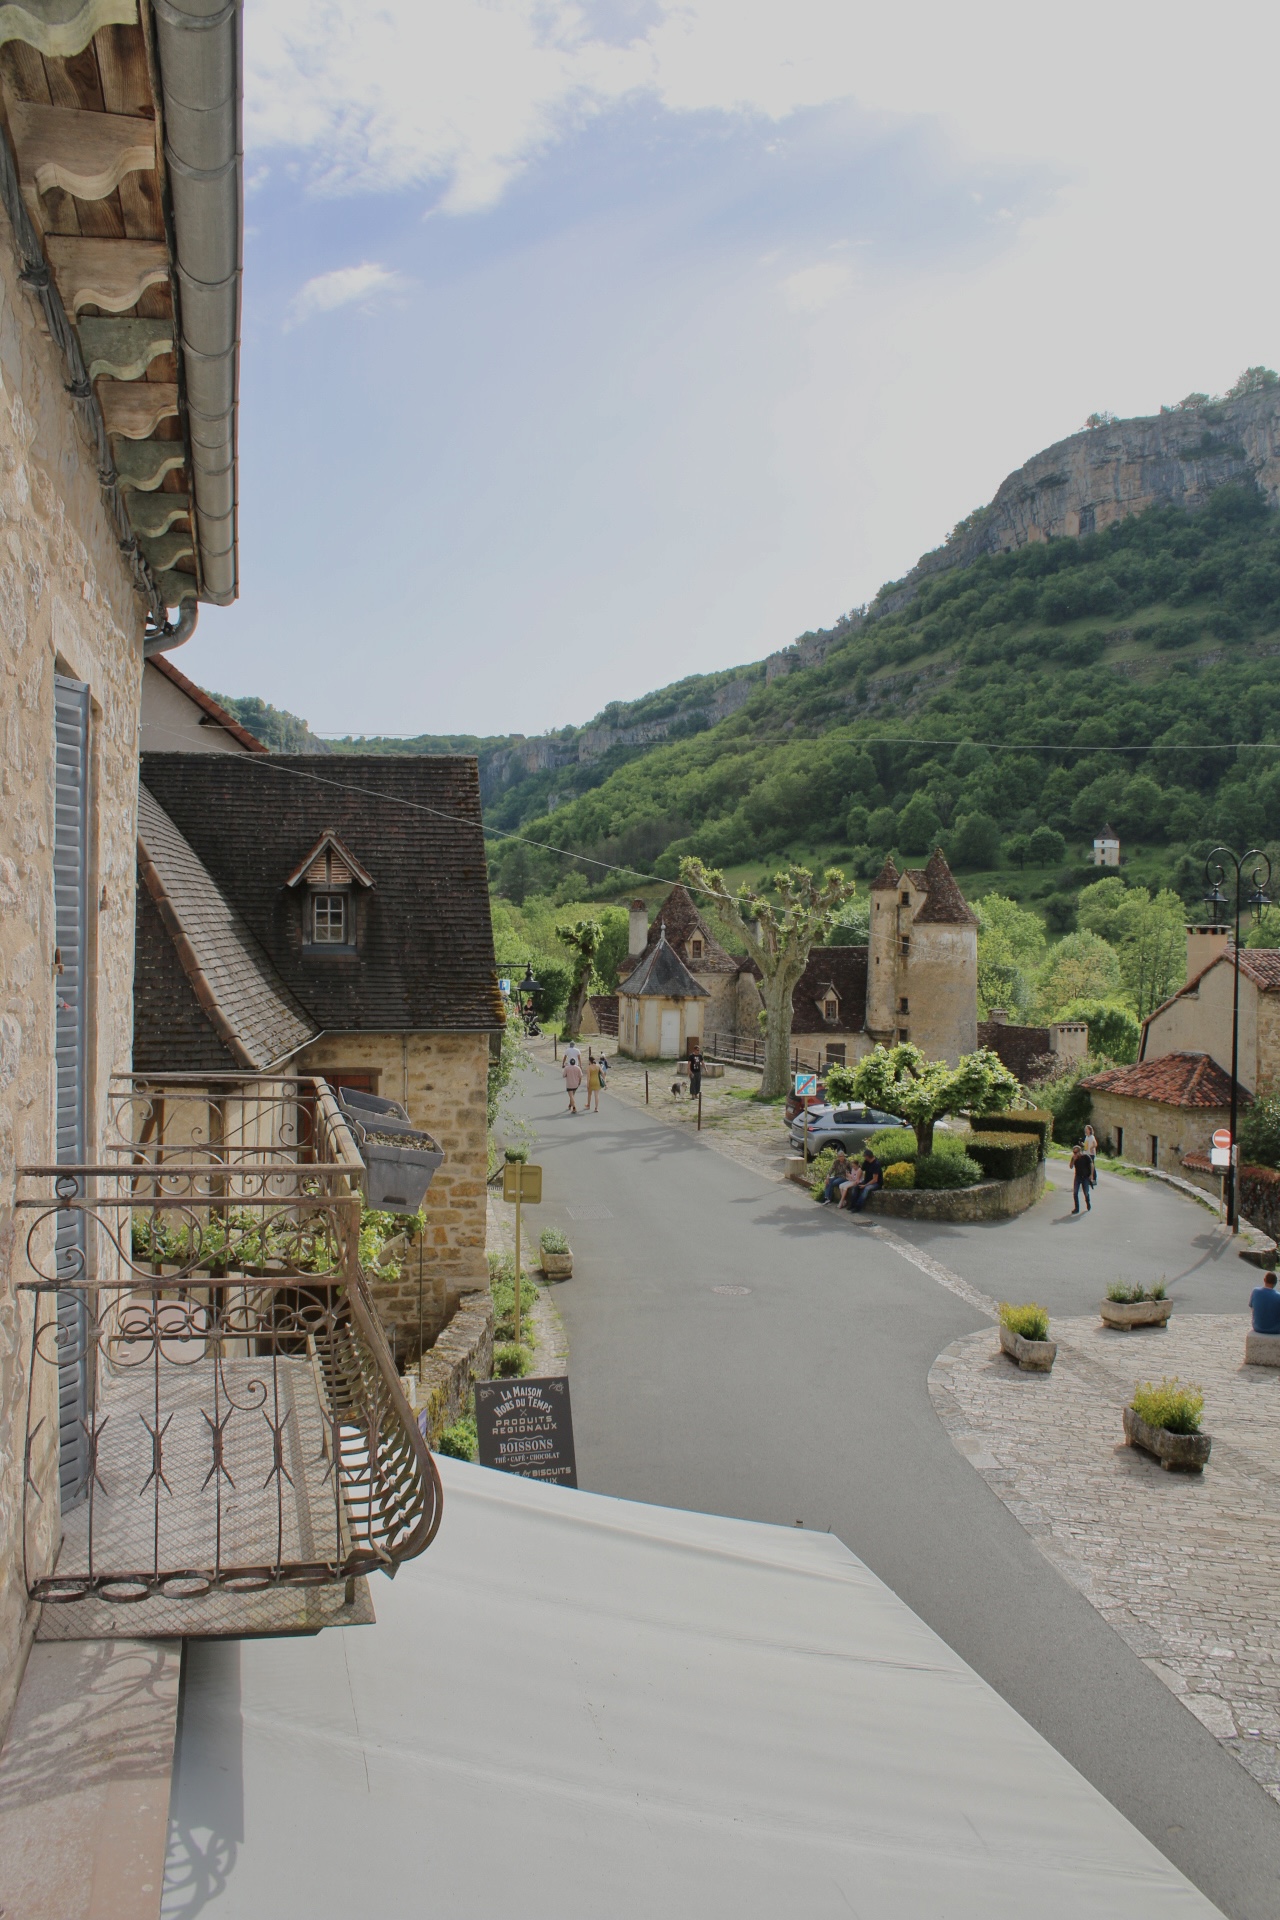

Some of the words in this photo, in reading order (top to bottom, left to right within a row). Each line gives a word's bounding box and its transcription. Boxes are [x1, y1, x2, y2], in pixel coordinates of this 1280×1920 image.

[516, 1399, 526, 1408] DU
[495, 1415, 553, 1427] PRODUITS
[492, 1422, 557, 1435] REGIONAUX
[500, 1439, 553, 1454] BOISSONS
[510, 1454, 525, 1463] CAFÉ
[529, 1452, 559, 1461] CHOCOLAT
[532, 1467, 571, 1477] BISCUITS
